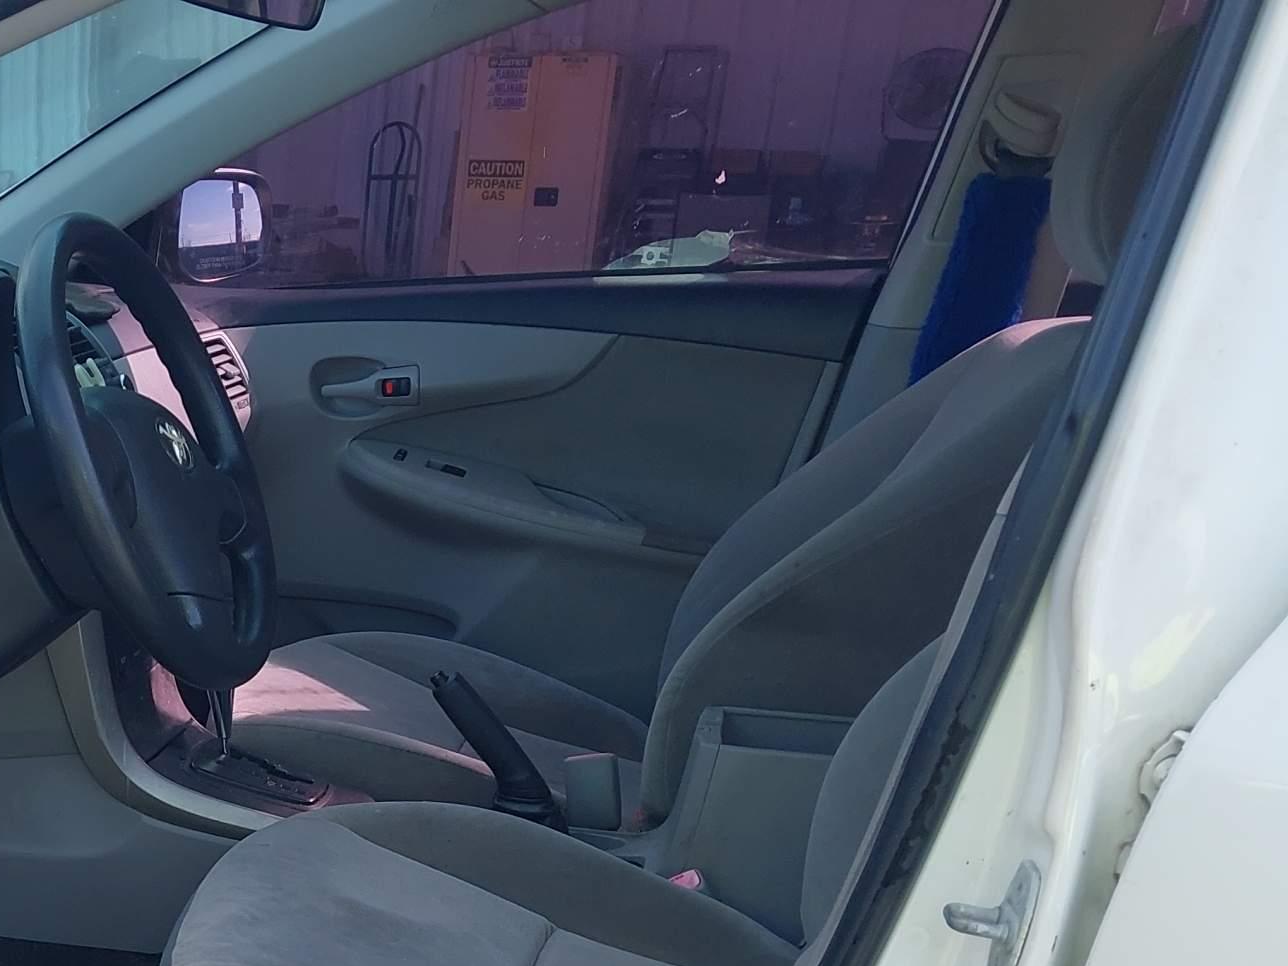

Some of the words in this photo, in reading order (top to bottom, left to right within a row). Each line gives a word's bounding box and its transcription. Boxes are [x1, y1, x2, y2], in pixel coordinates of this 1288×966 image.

[470, 161, 523, 176] CAUTION
[467, 178, 523, 190] PROPANE
[481, 190, 505, 201] GAS
